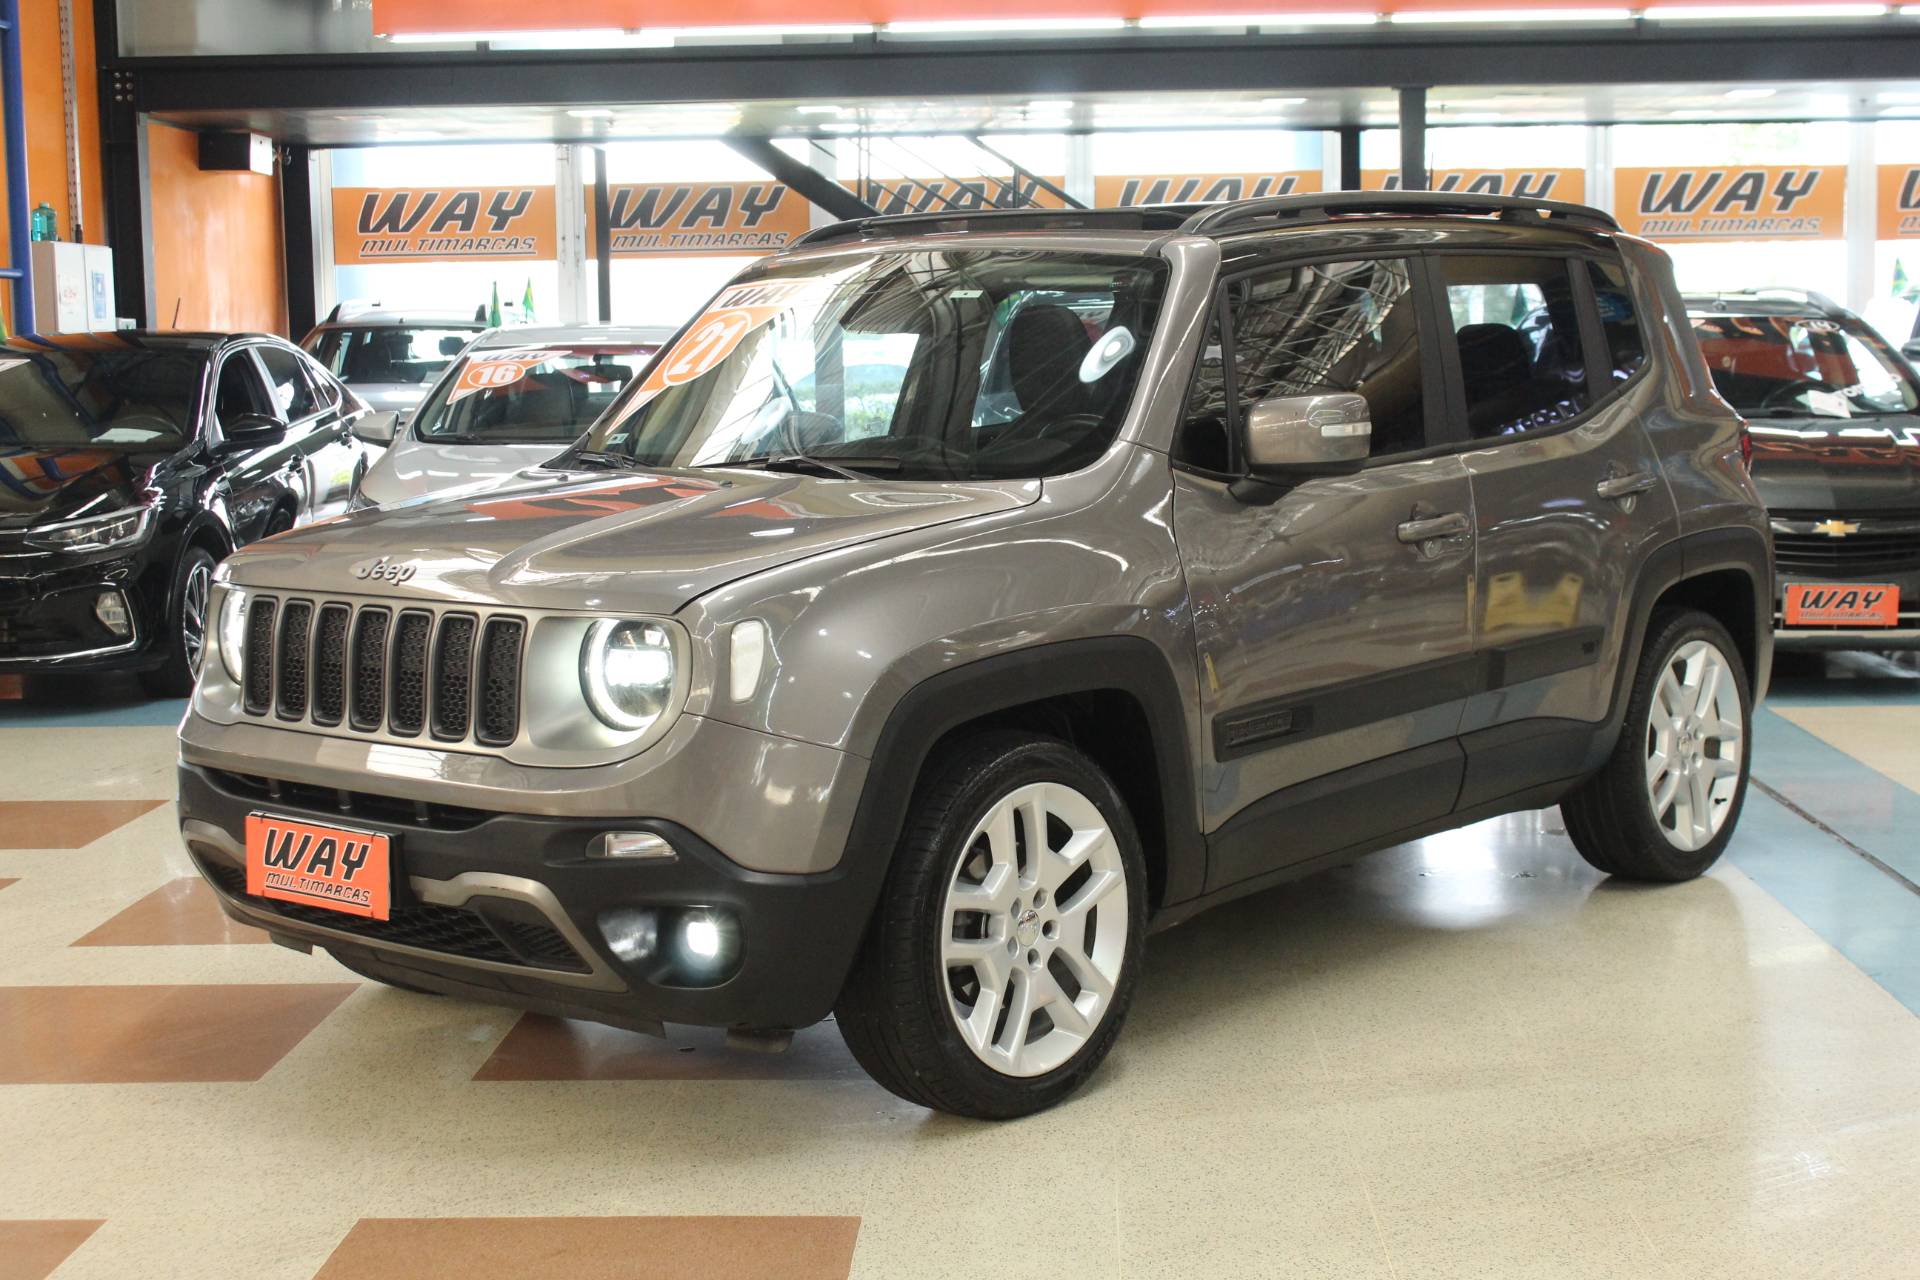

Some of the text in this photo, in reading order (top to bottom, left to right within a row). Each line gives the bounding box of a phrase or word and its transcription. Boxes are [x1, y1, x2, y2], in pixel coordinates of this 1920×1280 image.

[1638, 169, 1820, 214] WAY
[357, 190, 535, 234] WAY
[610, 184, 786, 230] WAY
[612, 232, 788, 248] MULTIMARCAS
[1641, 217, 1820, 233] MULTIMARCAS
[361, 236, 536, 252] MULTIMARCAS
[666, 321, 748, 375] 21
[478, 364, 519, 385] 16
[354, 556, 417, 586] Jeep
[1800, 590, 1884, 609] WAY
[264, 827, 371, 882] WAY
[265, 872, 371, 902] MULTIMARCAS
